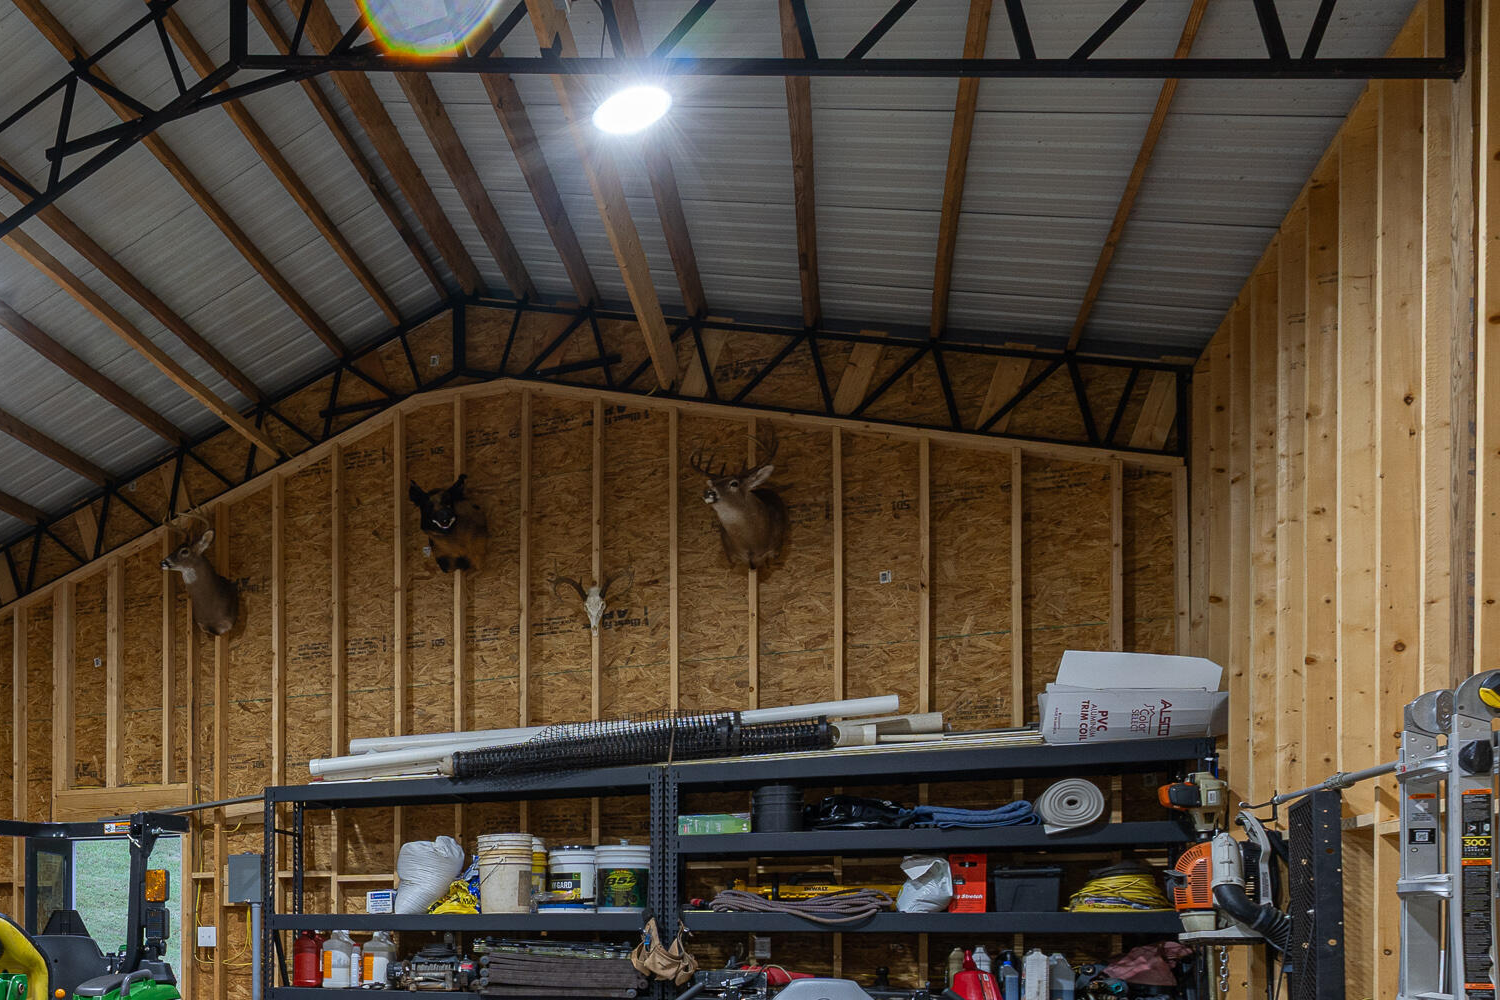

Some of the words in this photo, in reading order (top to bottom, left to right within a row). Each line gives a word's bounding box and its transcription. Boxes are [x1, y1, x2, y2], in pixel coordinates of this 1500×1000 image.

[1080, 699, 1091, 721] TRIM
[1089, 703, 1098, 738] ALUMINUM
[1096, 709, 1109, 732] PVC
[1129, 709, 1139, 732] SELECT
[1138, 708, 1148, 734] Color
[1157, 698, 1173, 736] ALSCO
[1078, 722, 1090, 741] COIL
[1463, 838, 1487, 847] 300
